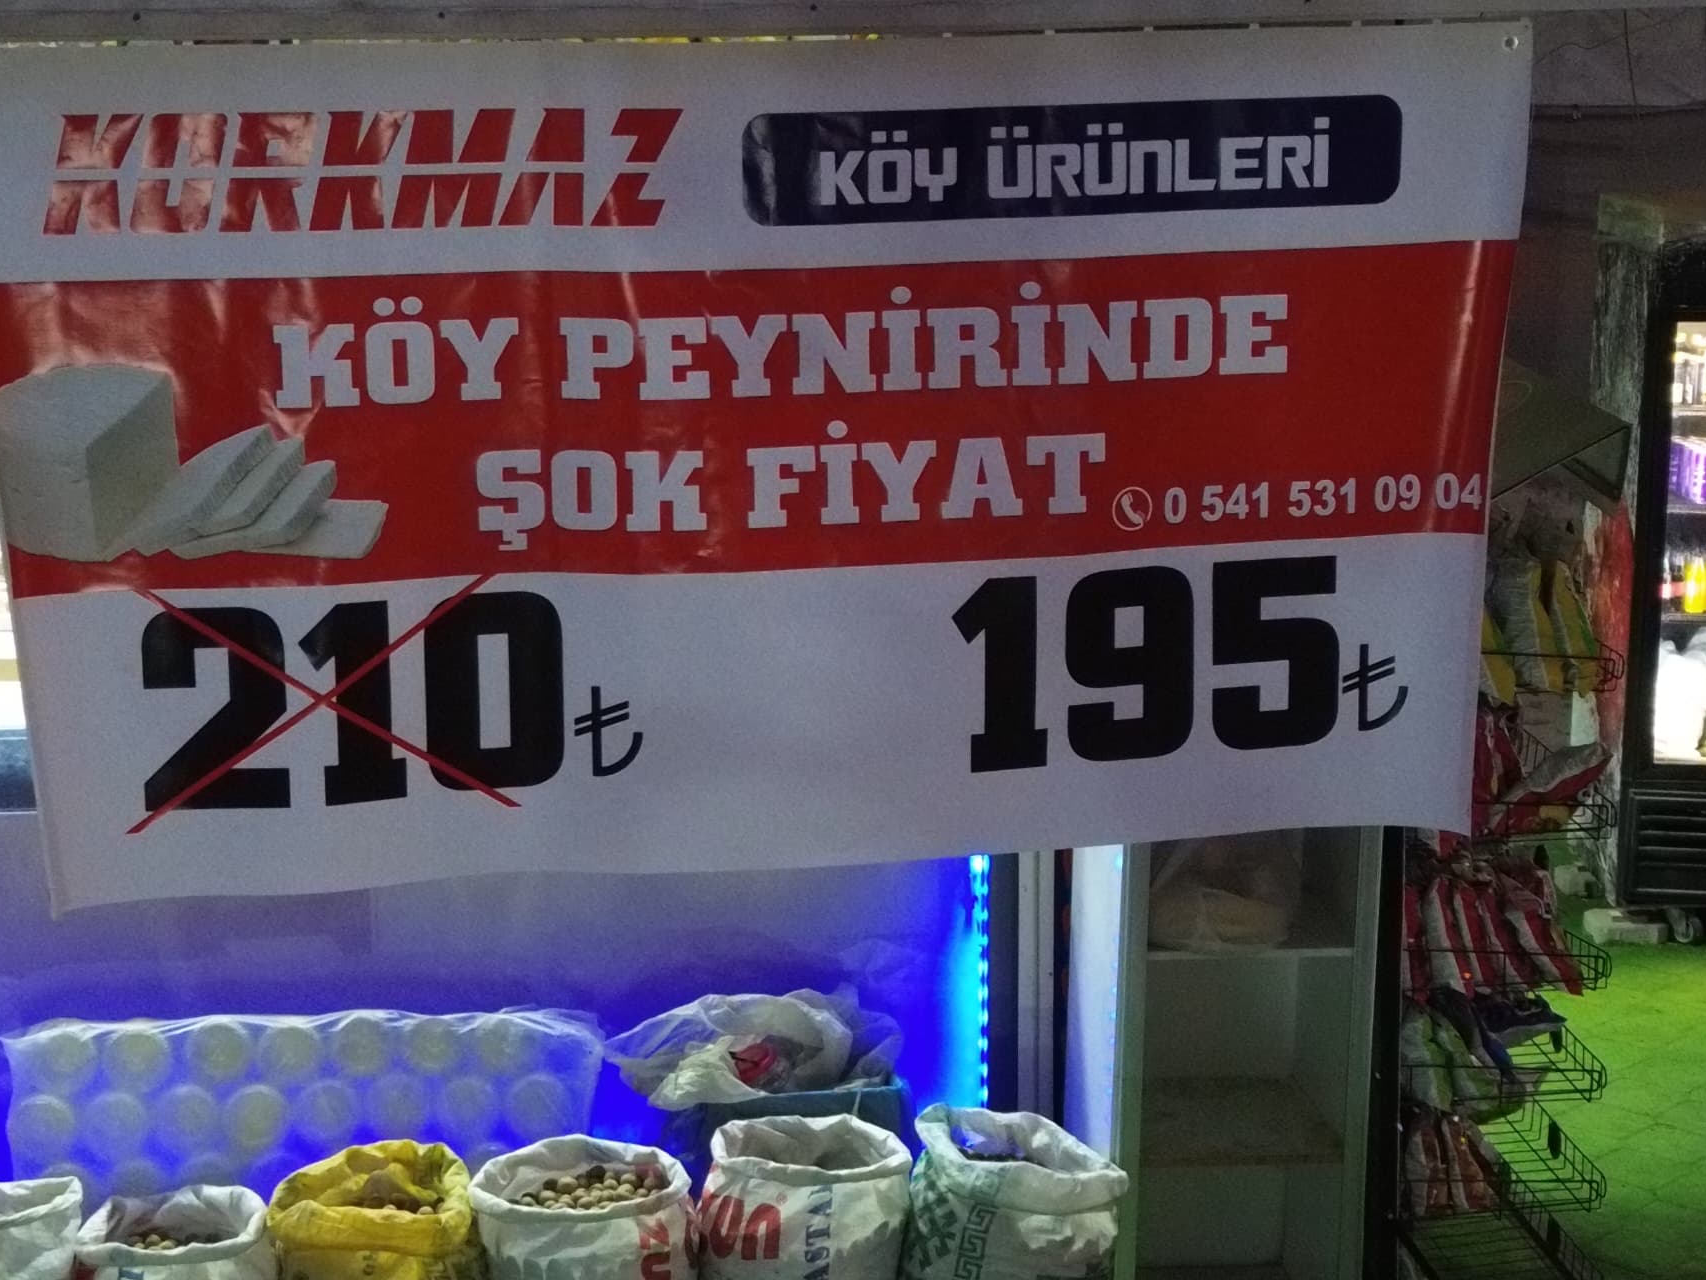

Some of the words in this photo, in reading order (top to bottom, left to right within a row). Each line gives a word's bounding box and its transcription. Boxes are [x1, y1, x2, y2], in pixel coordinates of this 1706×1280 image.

[42, 106, 685, 236] KORKMAZ
[819, 129, 961, 206] KÖY
[985, 115, 1333, 200] ÜRÜNLERİ
[274, 296, 520, 410] KÖY
[561, 281, 1290, 401] PEYNİRİNDE
[476, 446, 708, 551] ŞOK
[747, 420, 1108, 531] FİYAT
[1164, 487, 1185, 522] 0
[1199, 482, 1274, 519] 541
[1288, 479, 1363, 517] 531
[1372, 476, 1424, 514] 09
[1433, 473, 1484, 511] 04
